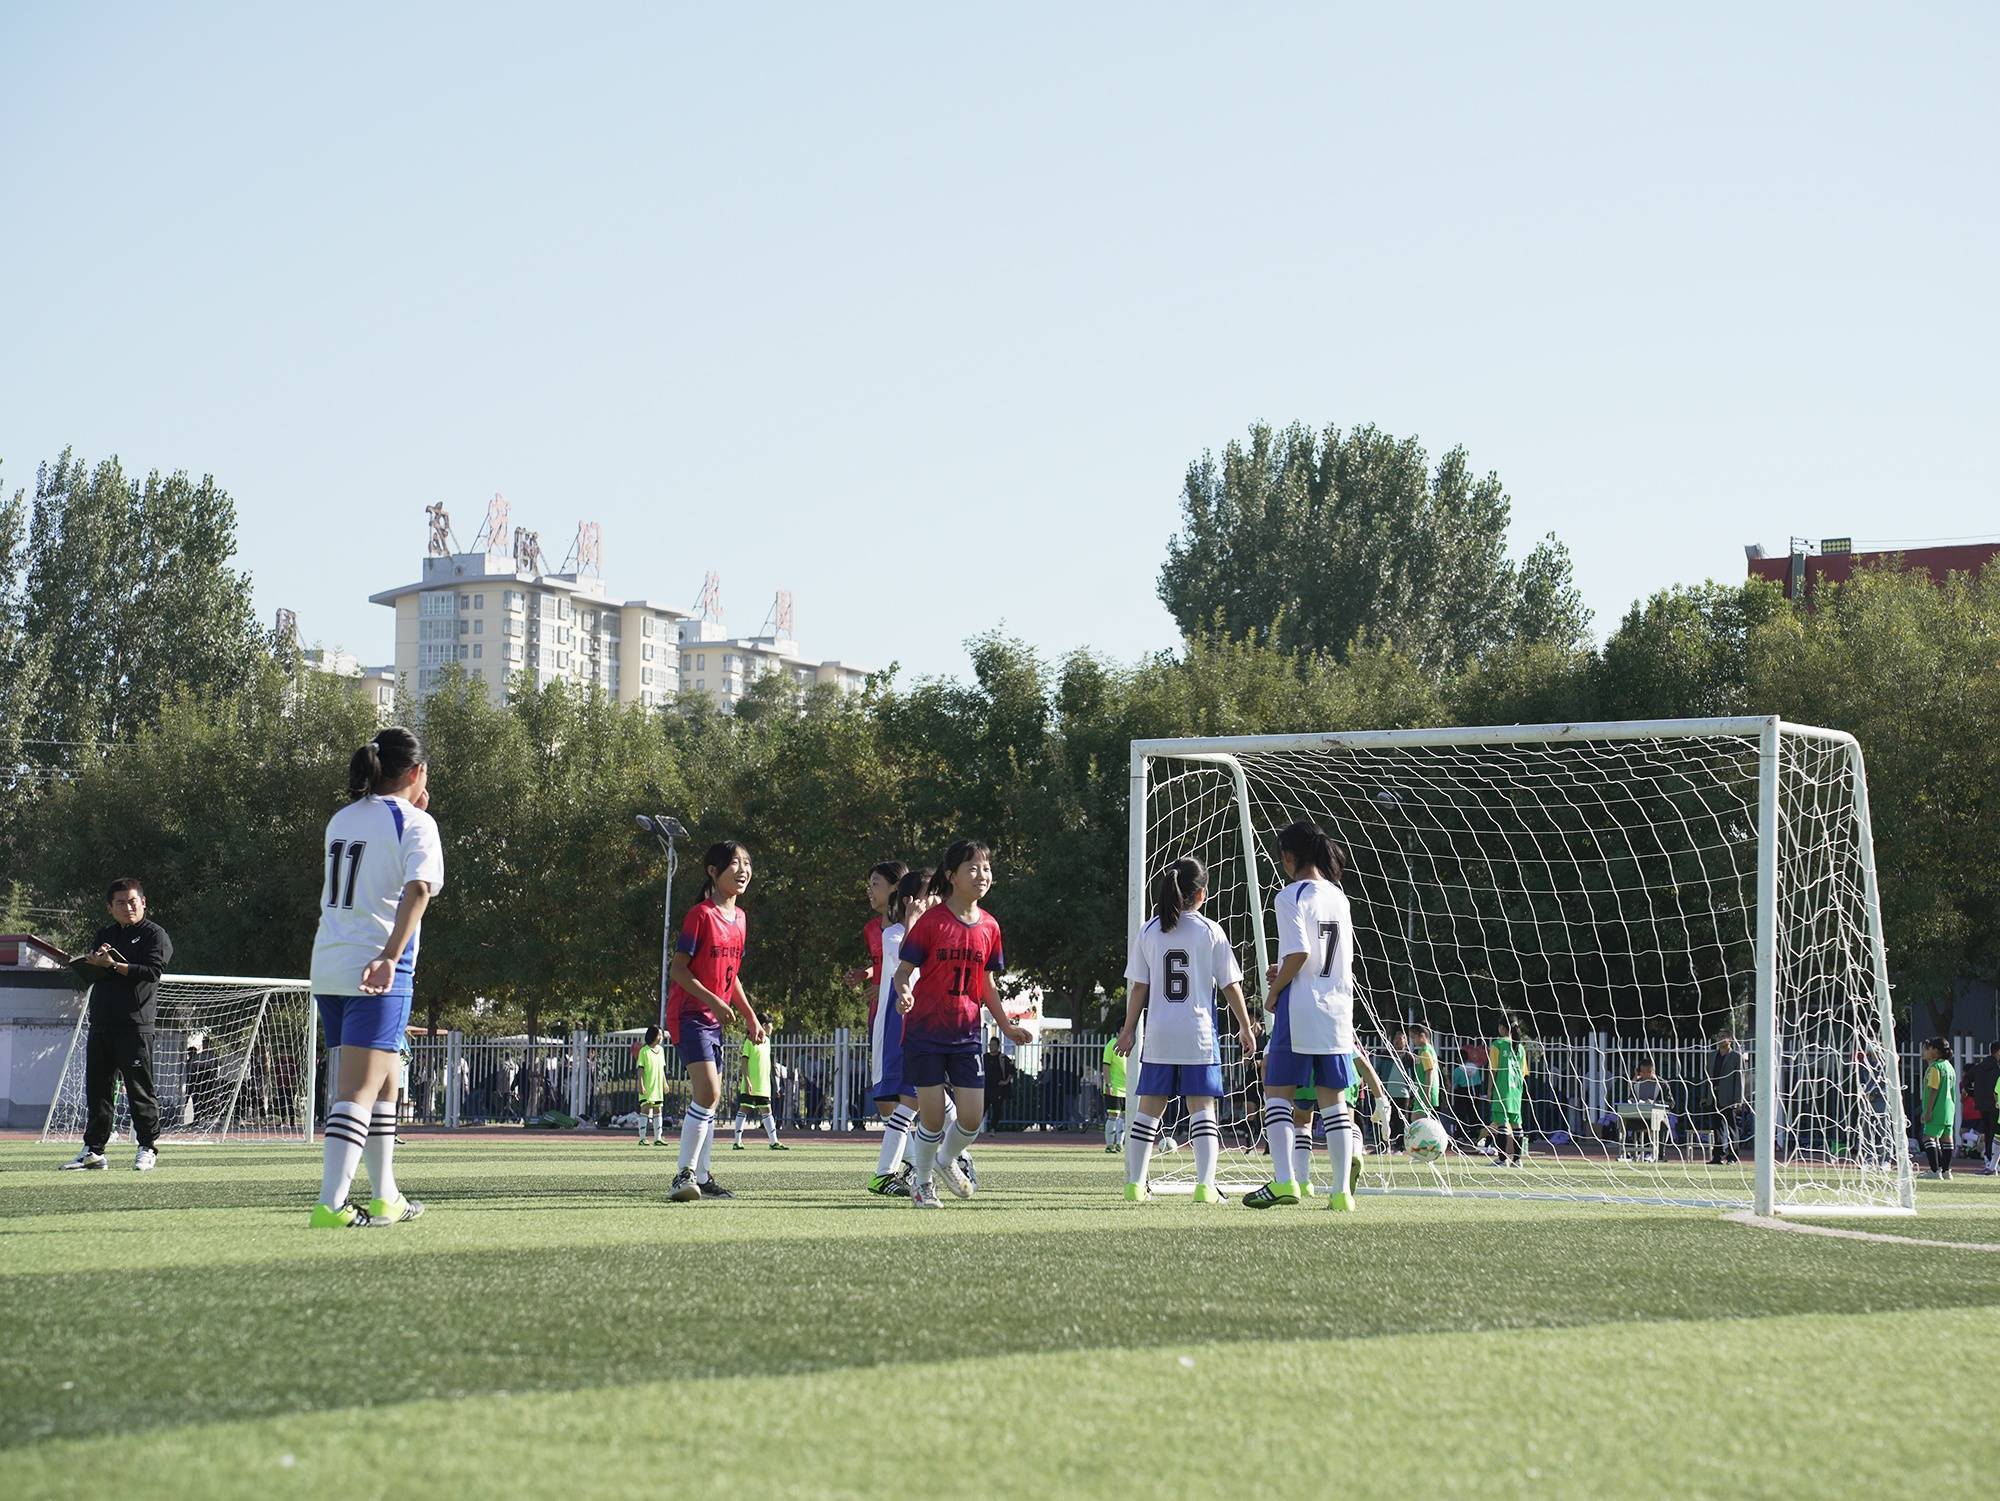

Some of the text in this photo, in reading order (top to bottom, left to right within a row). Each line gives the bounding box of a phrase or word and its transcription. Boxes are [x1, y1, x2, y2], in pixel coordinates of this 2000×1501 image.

[327, 839, 367, 910] 11
[1163, 949, 1189, 1003] 6
[1317, 921, 1339, 977] 7
[725, 965, 733, 992] 9
[948, 966, 971, 996] 11
